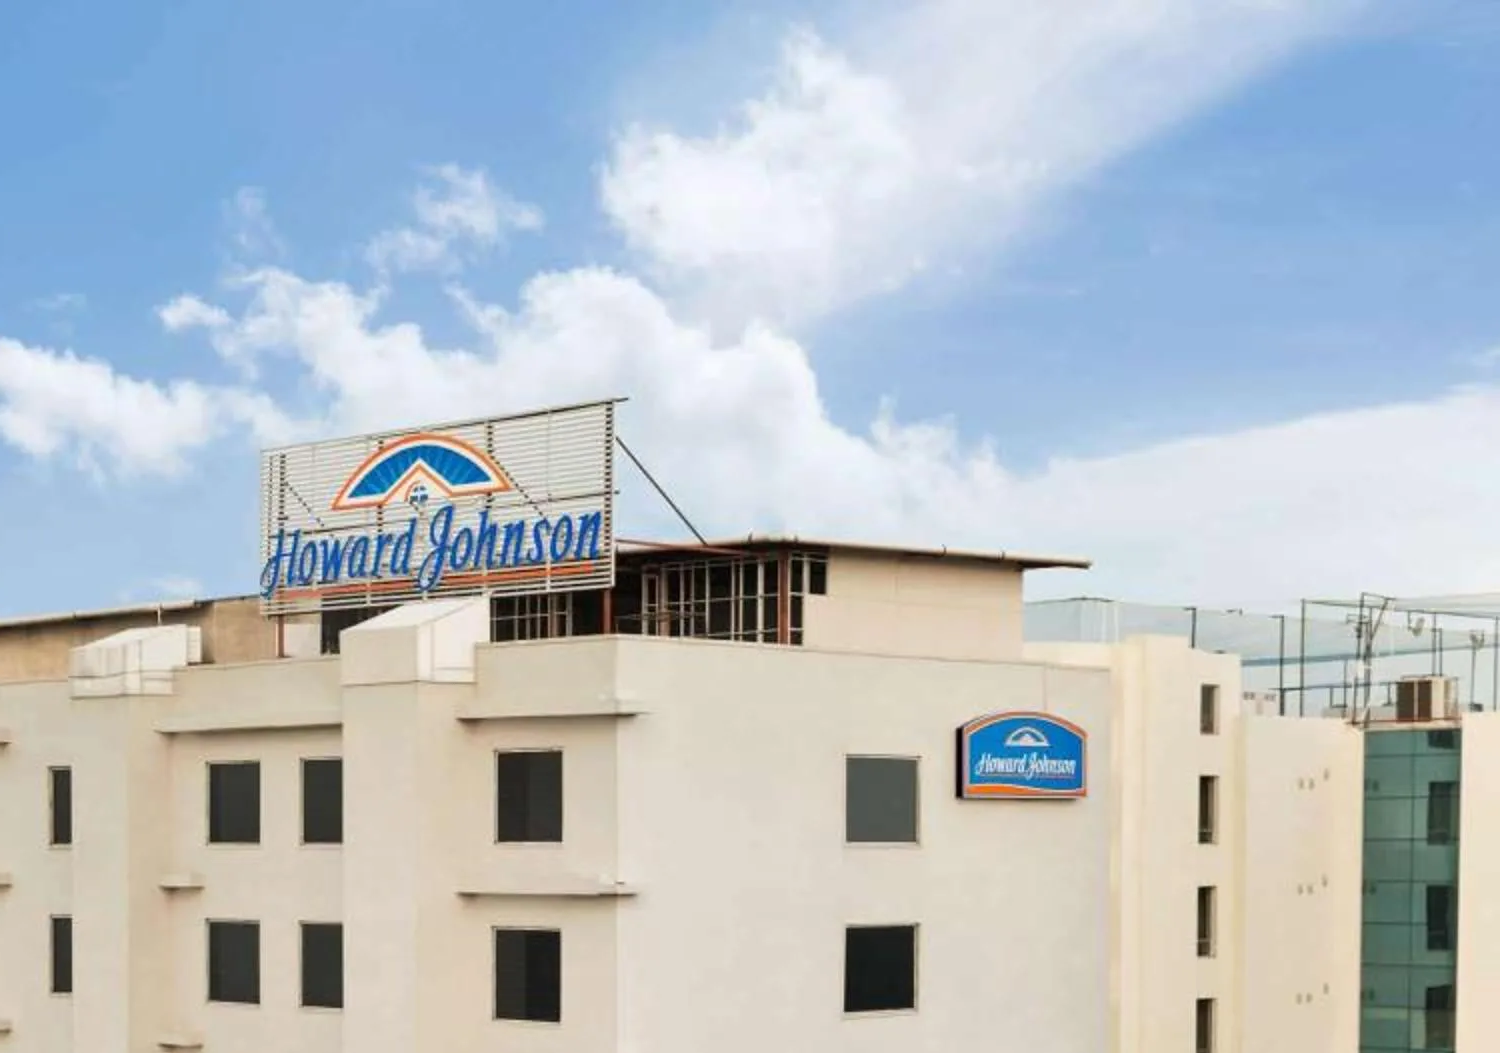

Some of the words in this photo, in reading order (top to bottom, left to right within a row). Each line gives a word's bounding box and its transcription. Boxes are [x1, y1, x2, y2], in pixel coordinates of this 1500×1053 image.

[260, 517, 417, 599] Howard
[417, 504, 602, 592] Johnson
[975, 752, 1027, 776] Howard
[1024, 752, 1076, 780] Johnson
